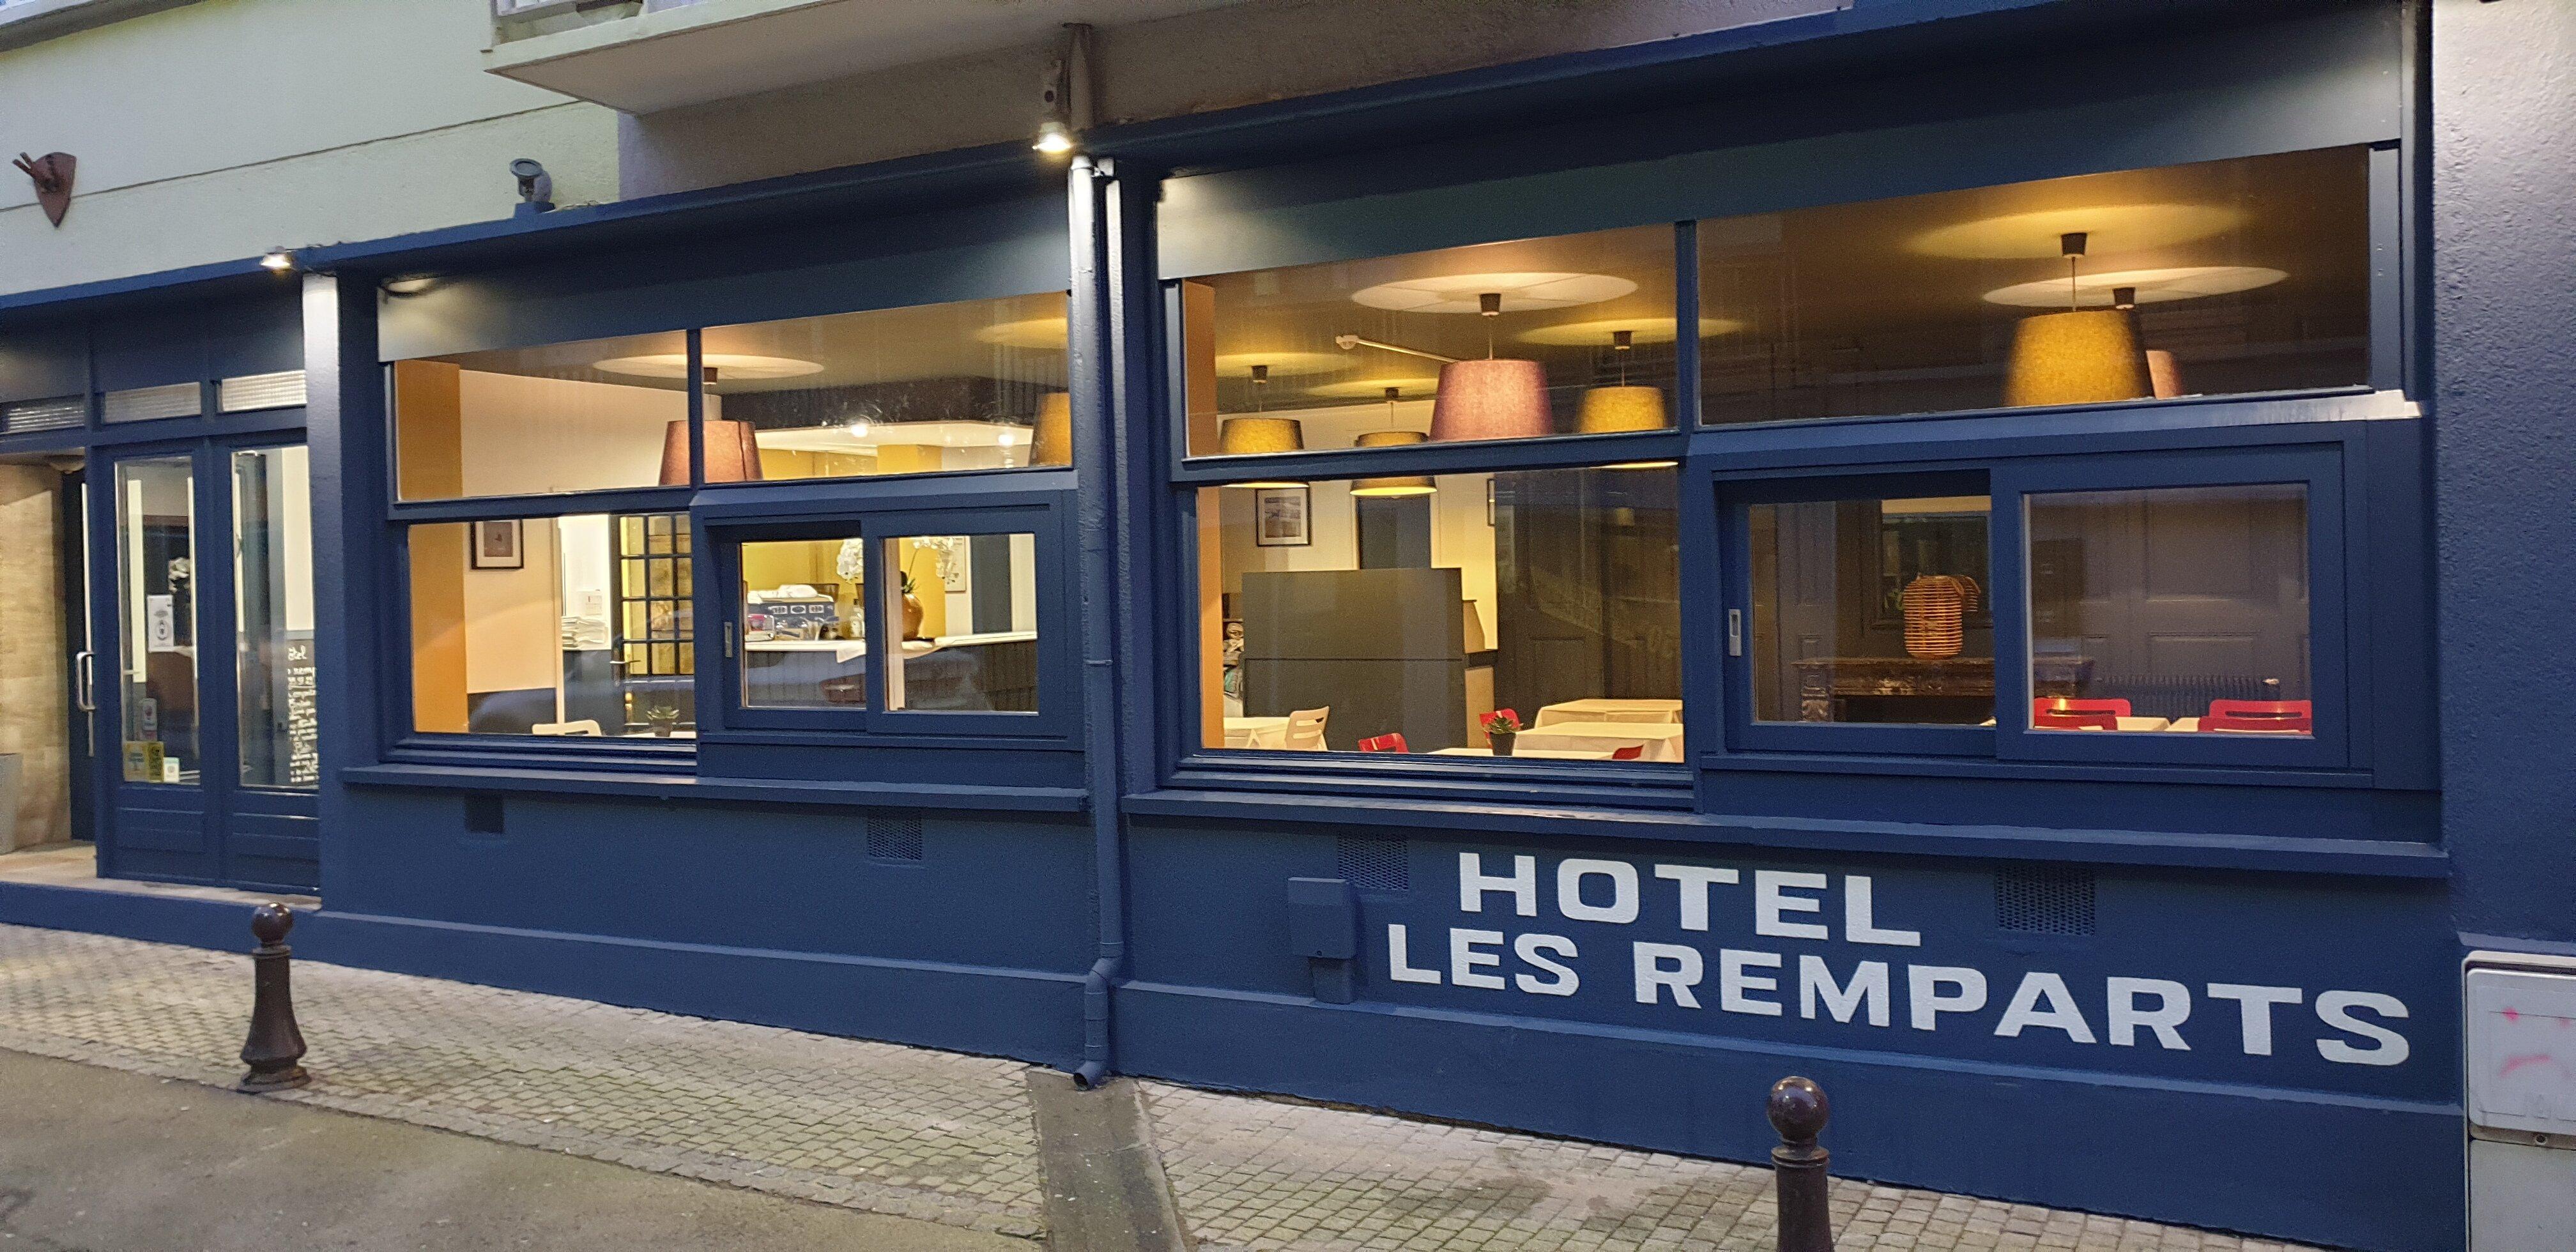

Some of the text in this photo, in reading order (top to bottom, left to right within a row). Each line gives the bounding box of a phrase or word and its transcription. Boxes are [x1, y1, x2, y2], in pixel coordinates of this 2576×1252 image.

[1459, 853, 1920, 946] HOTEL
[1388, 924, 2409, 1065] LES REMPARTS
